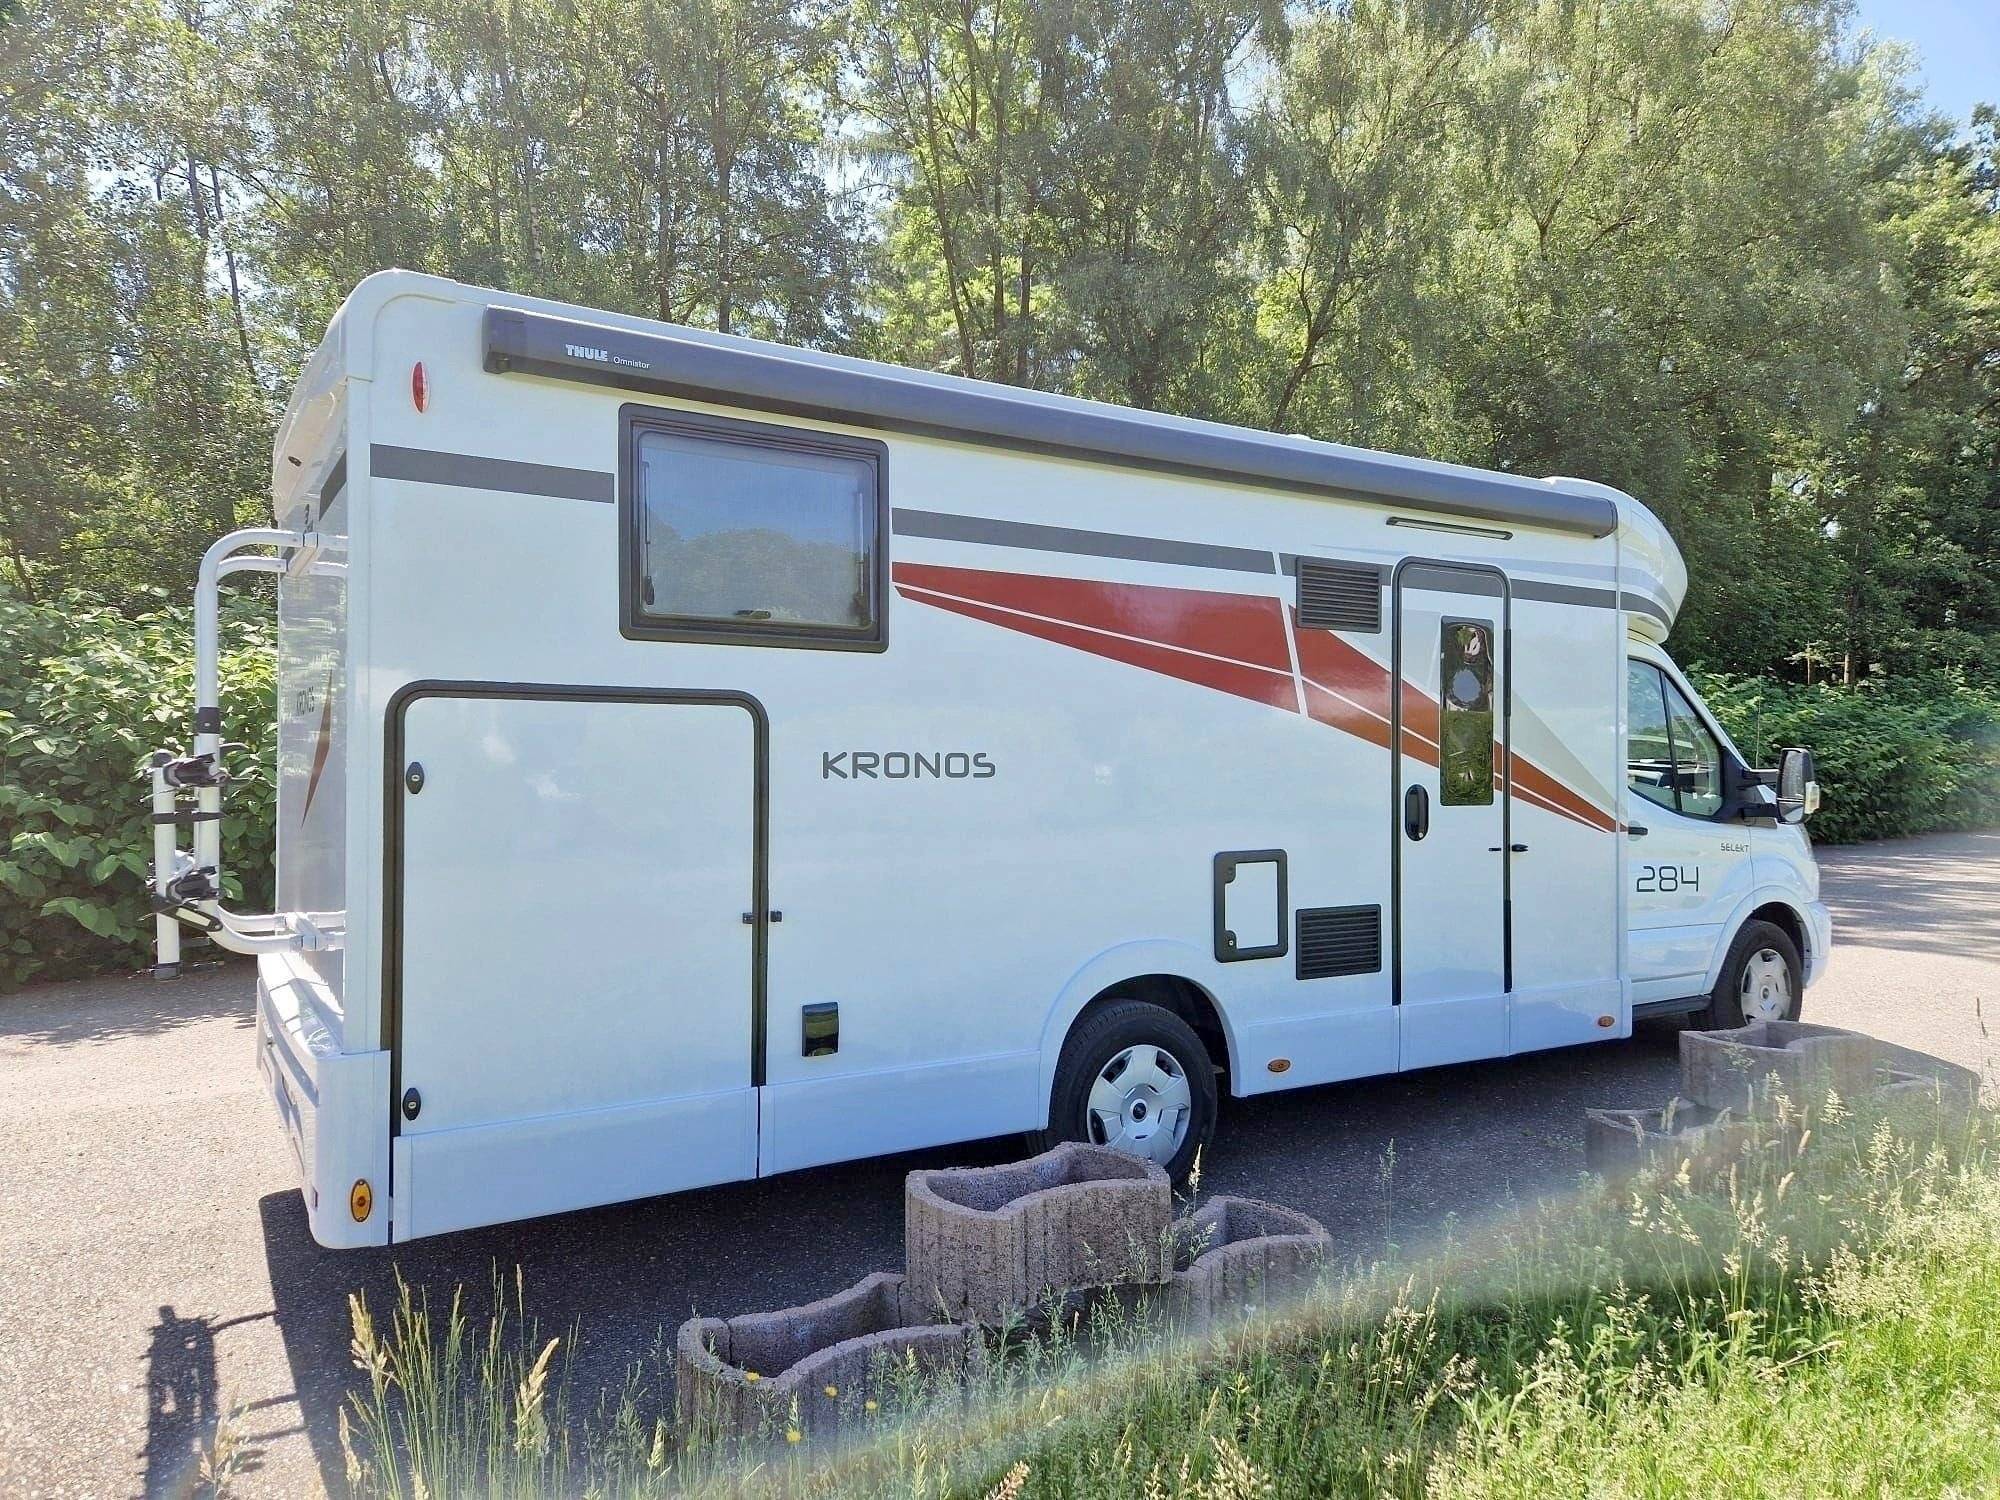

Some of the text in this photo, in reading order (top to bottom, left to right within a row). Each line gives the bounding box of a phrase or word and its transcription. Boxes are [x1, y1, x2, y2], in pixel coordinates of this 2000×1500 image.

[565, 344, 650, 369] THULE Omnistor
[822, 751, 996, 779] KRONOS
[1636, 865, 1699, 892] 284
